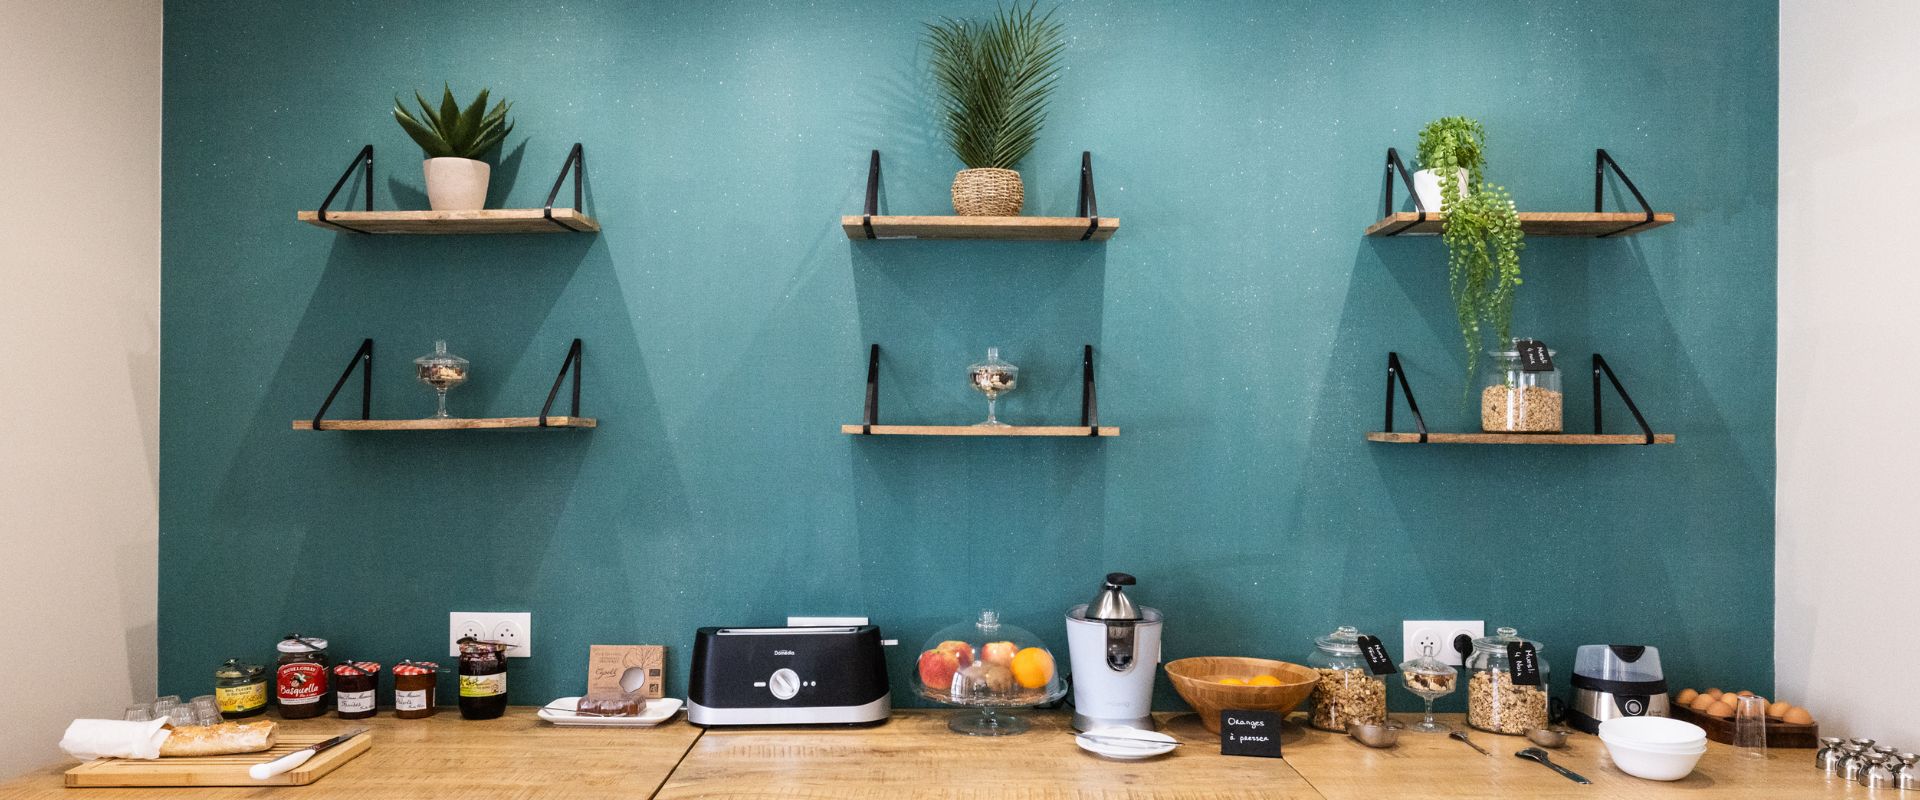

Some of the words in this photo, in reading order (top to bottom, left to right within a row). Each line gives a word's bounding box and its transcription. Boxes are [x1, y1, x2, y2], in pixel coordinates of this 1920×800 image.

[1525, 649, 1535, 674] Muesli
[280, 683, 318, 697] Basquella
[1228, 717, 1265, 729] Oranges
[1230, 732, 1236, 740] à
[1240, 735, 1269, 744] presser
